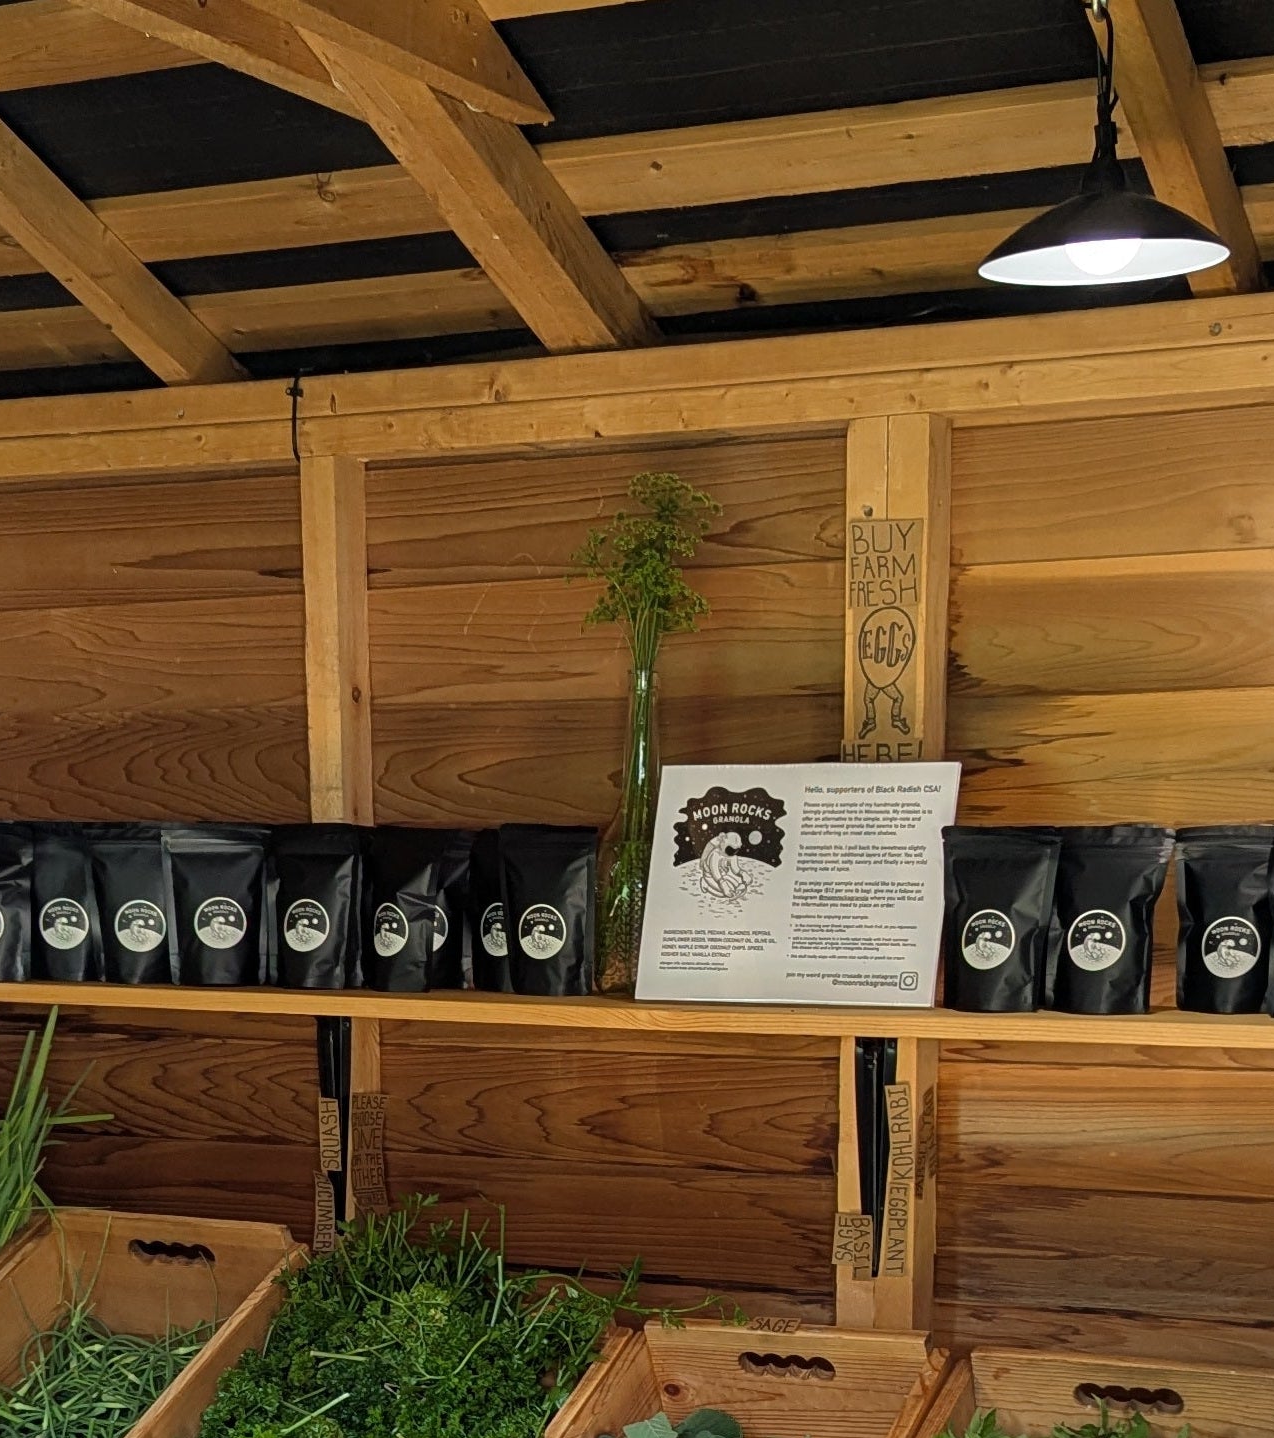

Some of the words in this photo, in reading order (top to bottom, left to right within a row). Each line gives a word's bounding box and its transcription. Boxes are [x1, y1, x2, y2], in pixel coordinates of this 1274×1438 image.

[852, 522, 915, 555] BUY
[850, 553, 916, 580] FARM
[849, 578, 918, 608] FRESH
[693, 803, 727, 821] MOON
[731, 802, 772, 821] ROCKS
[713, 815, 750, 824] GRANOLA
[320, 1100, 340, 1170] SQUASH
[887, 1087, 914, 1181] KOHLRABI
[835, 1217, 854, 1262] SAGE
[852, 1217, 871, 1280] BASIL
[886, 1184, 907, 1274] EGGPLANT
